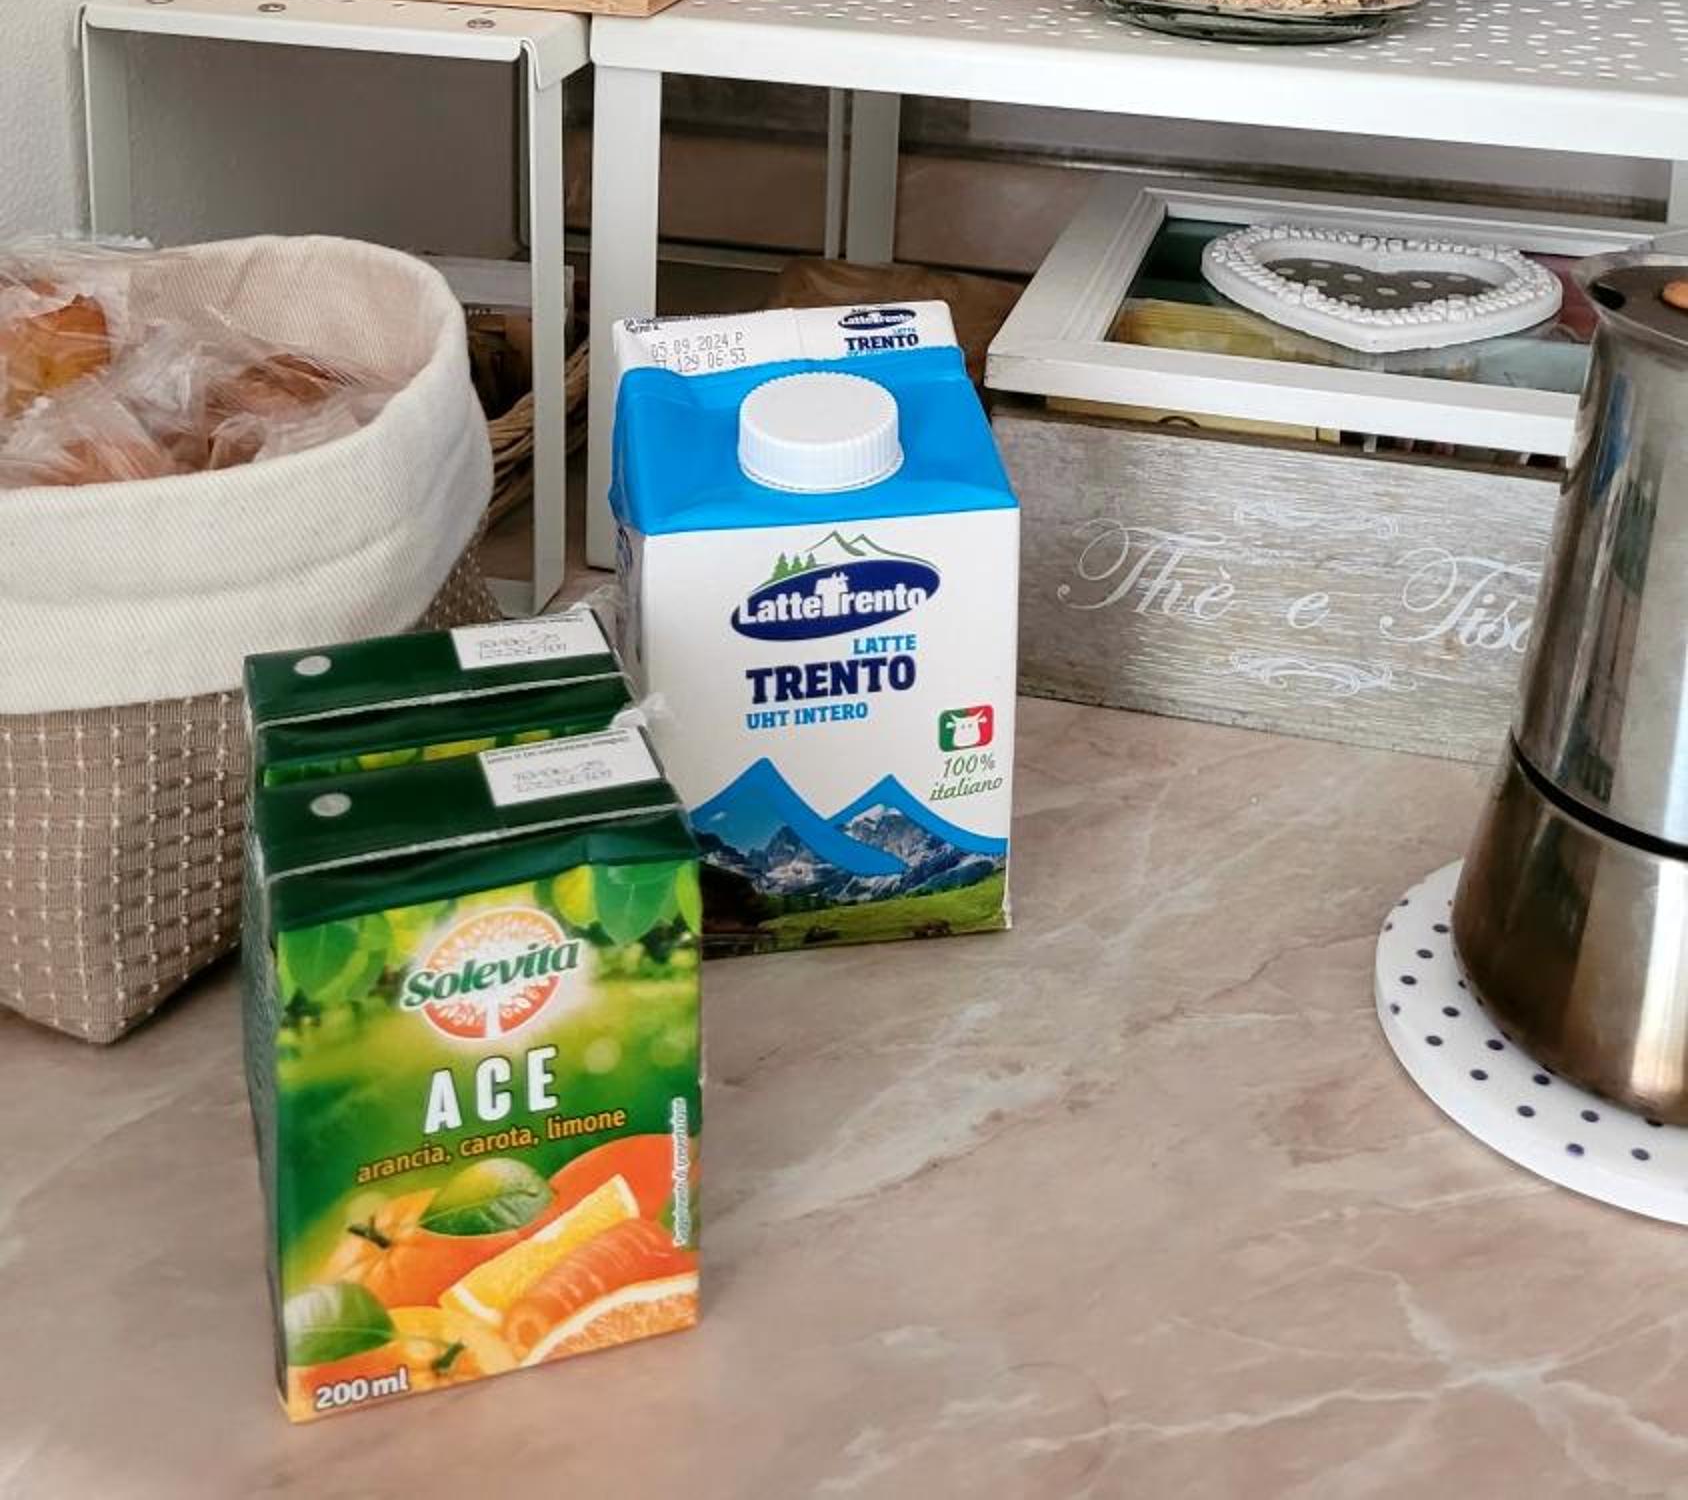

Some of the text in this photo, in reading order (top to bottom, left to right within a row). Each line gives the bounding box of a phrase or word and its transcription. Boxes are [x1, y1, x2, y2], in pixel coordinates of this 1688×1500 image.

[843, 333, 919, 351] TRENTO
[1056, 517, 1236, 621] Thè
[1287, 590, 1331, 630] e
[738, 574, 928, 626] LatteTrento
[853, 633, 918, 656] LATTE
[745, 654, 917, 706] TRENTO
[745, 701, 869, 731] UHT INTERO
[928, 776, 1004, 802] italiano
[942, 751, 996, 779] 100%
[403, 940, 580, 1006] Solevita
[423, 1045, 560, 1135] ACE
[357, 1108, 628, 1185] arancia, carota, limone
[315, 1366, 409, 1410] 200 ml
